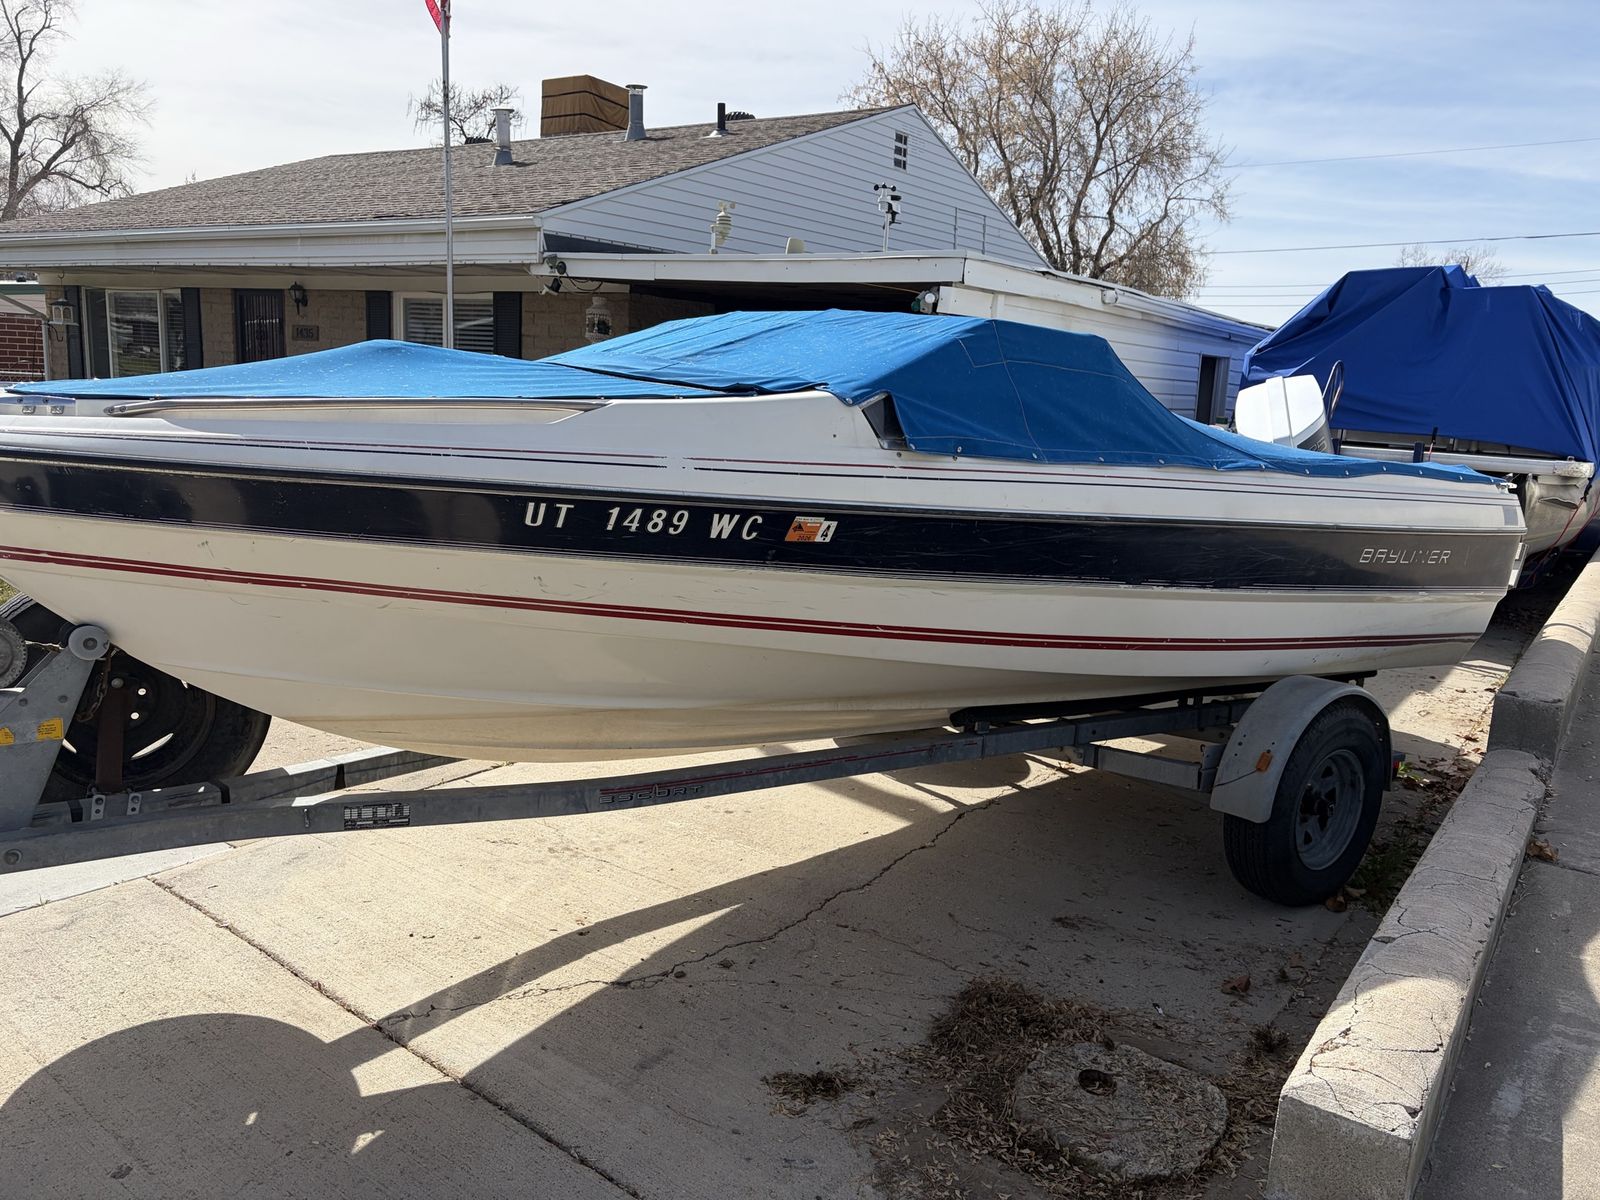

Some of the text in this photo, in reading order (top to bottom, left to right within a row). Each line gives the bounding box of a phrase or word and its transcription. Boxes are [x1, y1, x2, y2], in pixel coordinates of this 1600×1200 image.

[524, 502, 763, 541] UT 1489 WC
[599, 784, 703, 804] ESCORT
